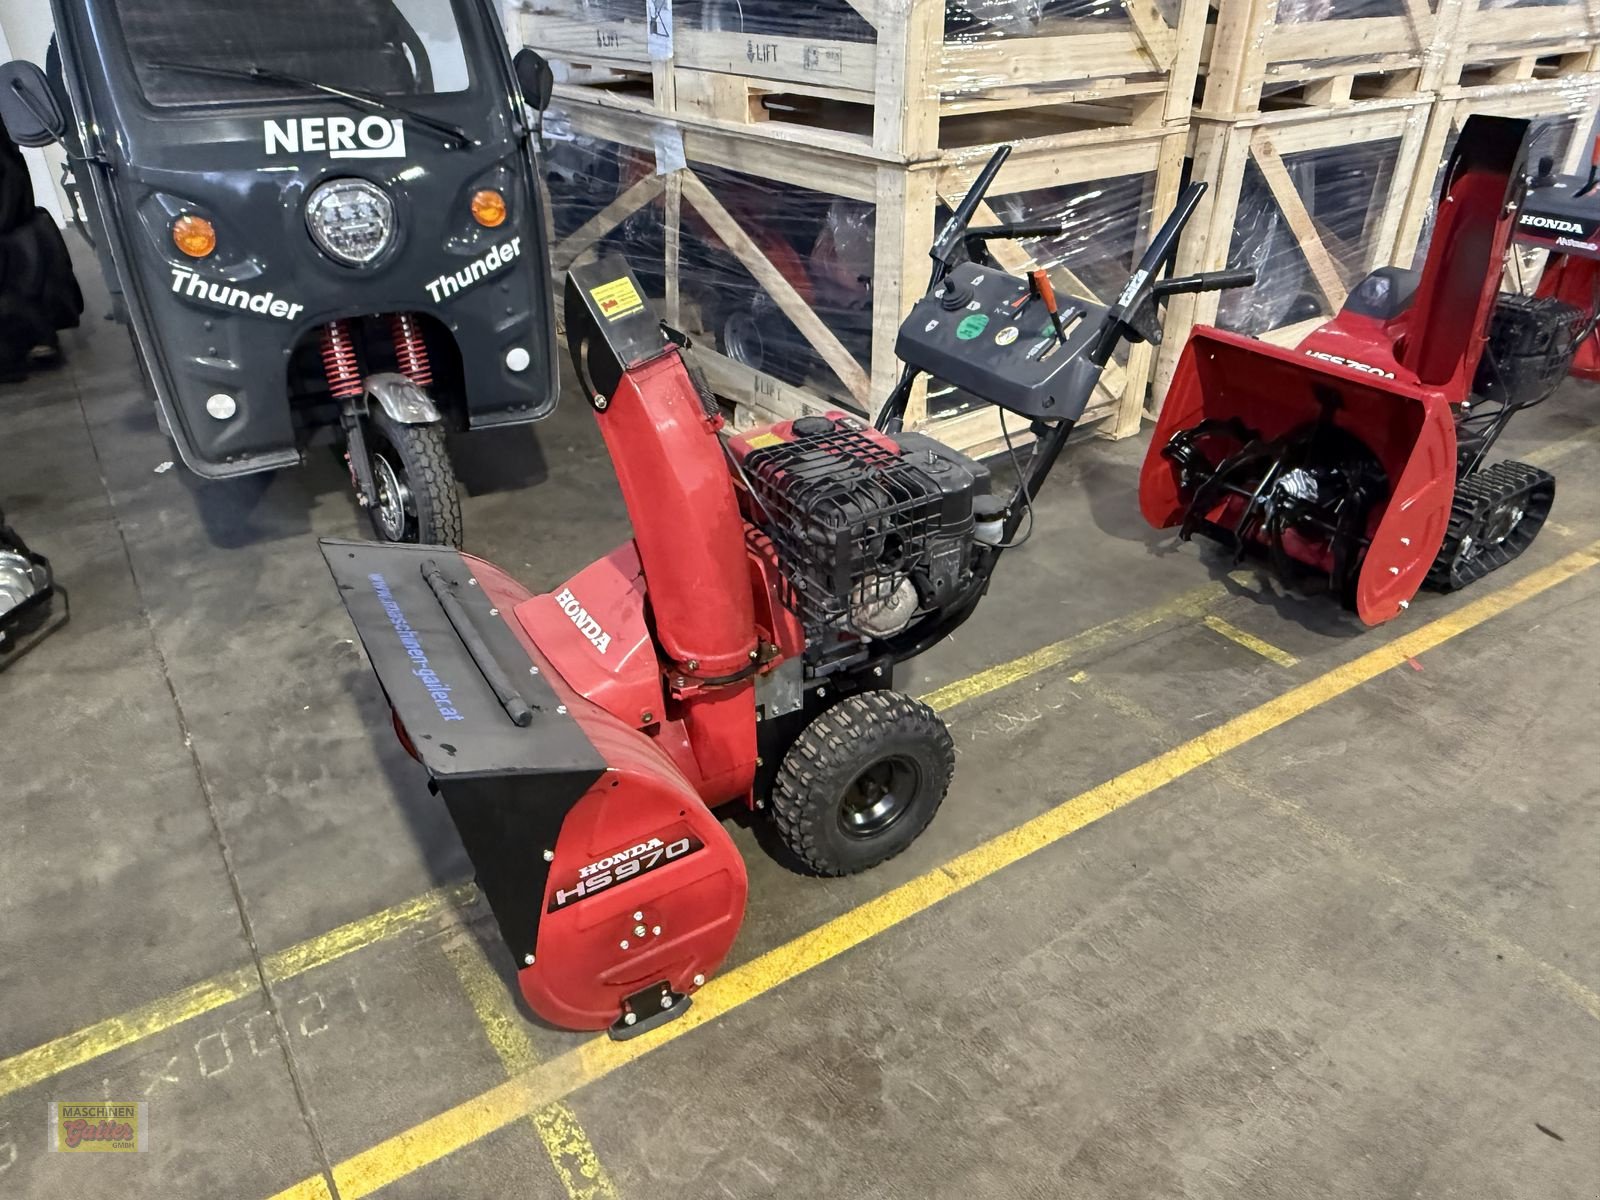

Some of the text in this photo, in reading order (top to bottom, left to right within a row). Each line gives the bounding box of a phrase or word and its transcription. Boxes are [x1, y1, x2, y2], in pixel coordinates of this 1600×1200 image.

[757, 44, 778, 62] LIFT
[264, 115, 394, 155] NERO
[1519, 214, 1584, 235] HONDA
[426, 236, 522, 304] Thunder
[170, 268, 304, 321] Thunder
[554, 587, 612, 655] HONDA
[555, 838, 691, 905] HS970
[578, 838, 664, 879] HONDA
